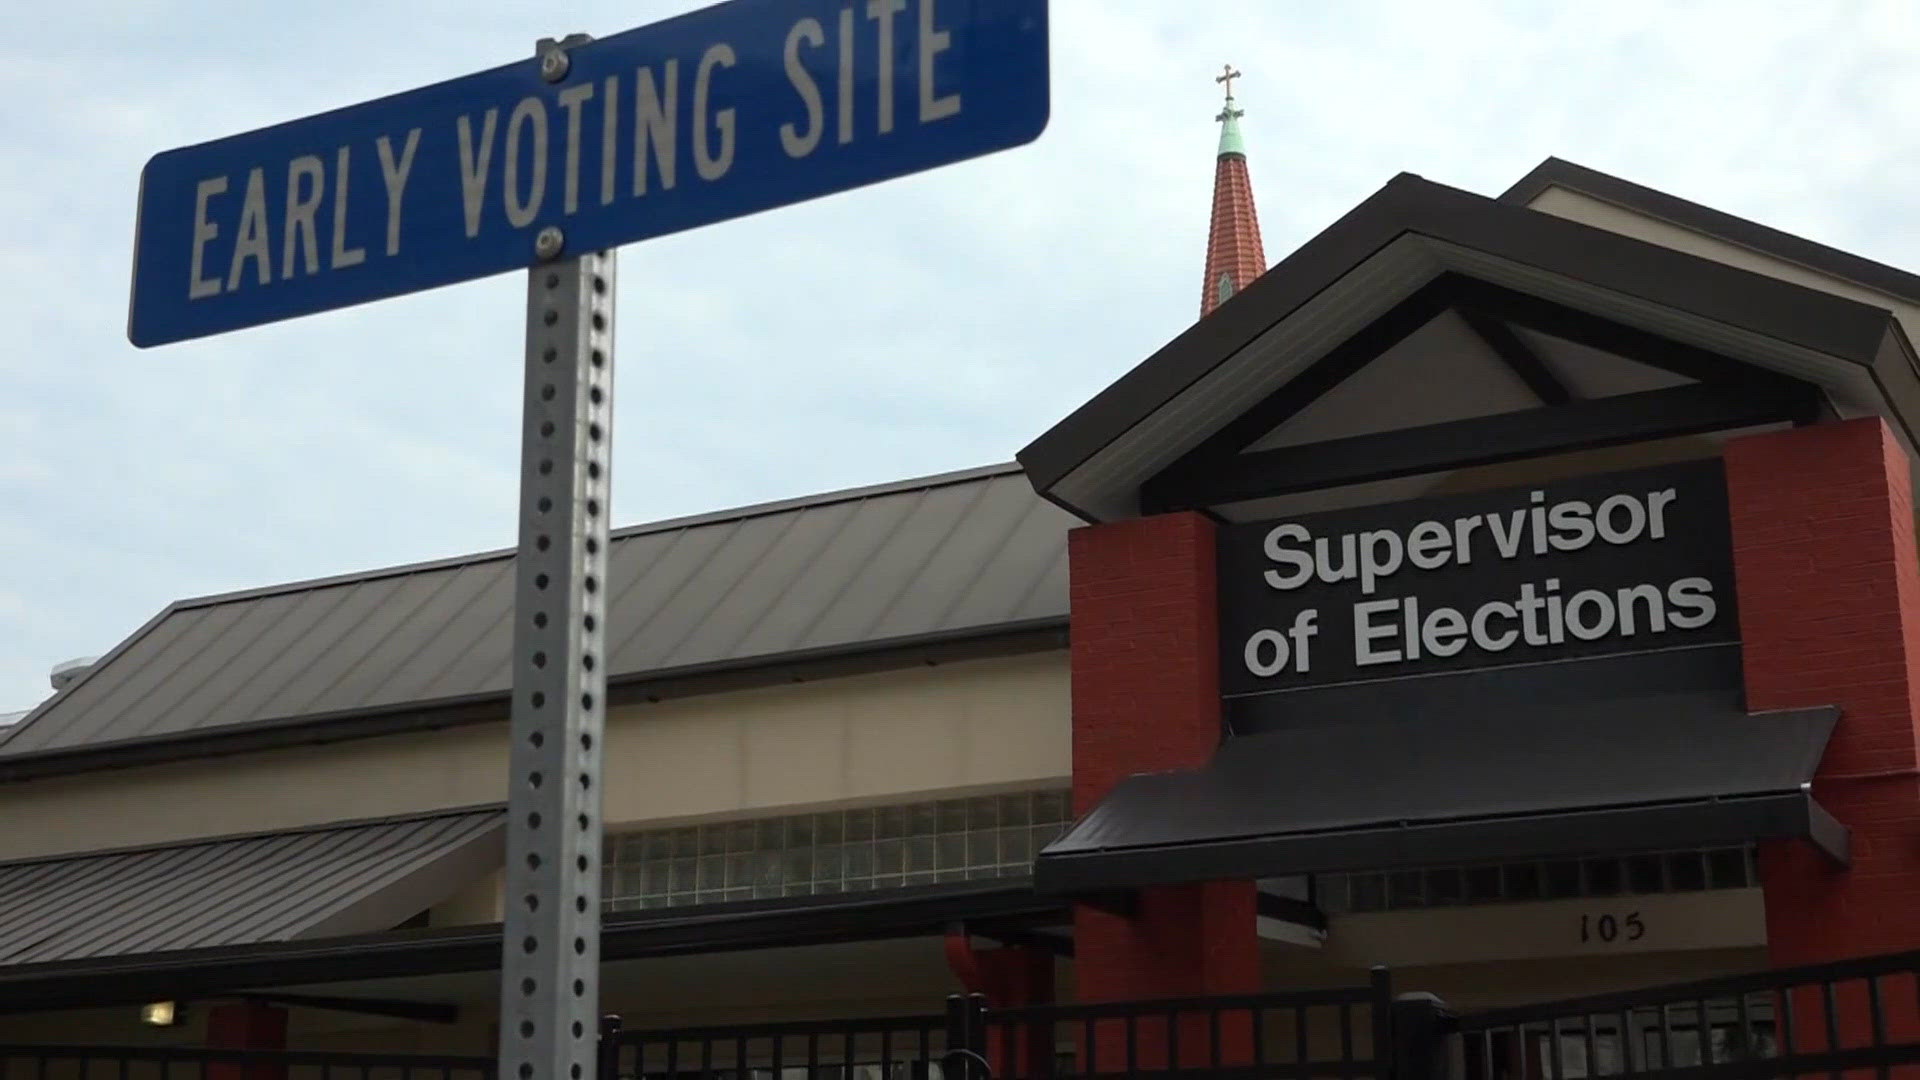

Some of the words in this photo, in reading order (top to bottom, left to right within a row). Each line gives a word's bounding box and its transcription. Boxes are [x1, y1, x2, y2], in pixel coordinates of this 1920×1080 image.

[188, 127, 422, 300] EARLY
[456, 43, 736, 239] VOTING
[780, 0, 963, 159] SITE
[1263, 488, 1677, 594] Supervisor
[1244, 609, 1319, 677] of
[1353, 576, 1717, 667] Elections
[1580, 911, 1646, 942] 105
